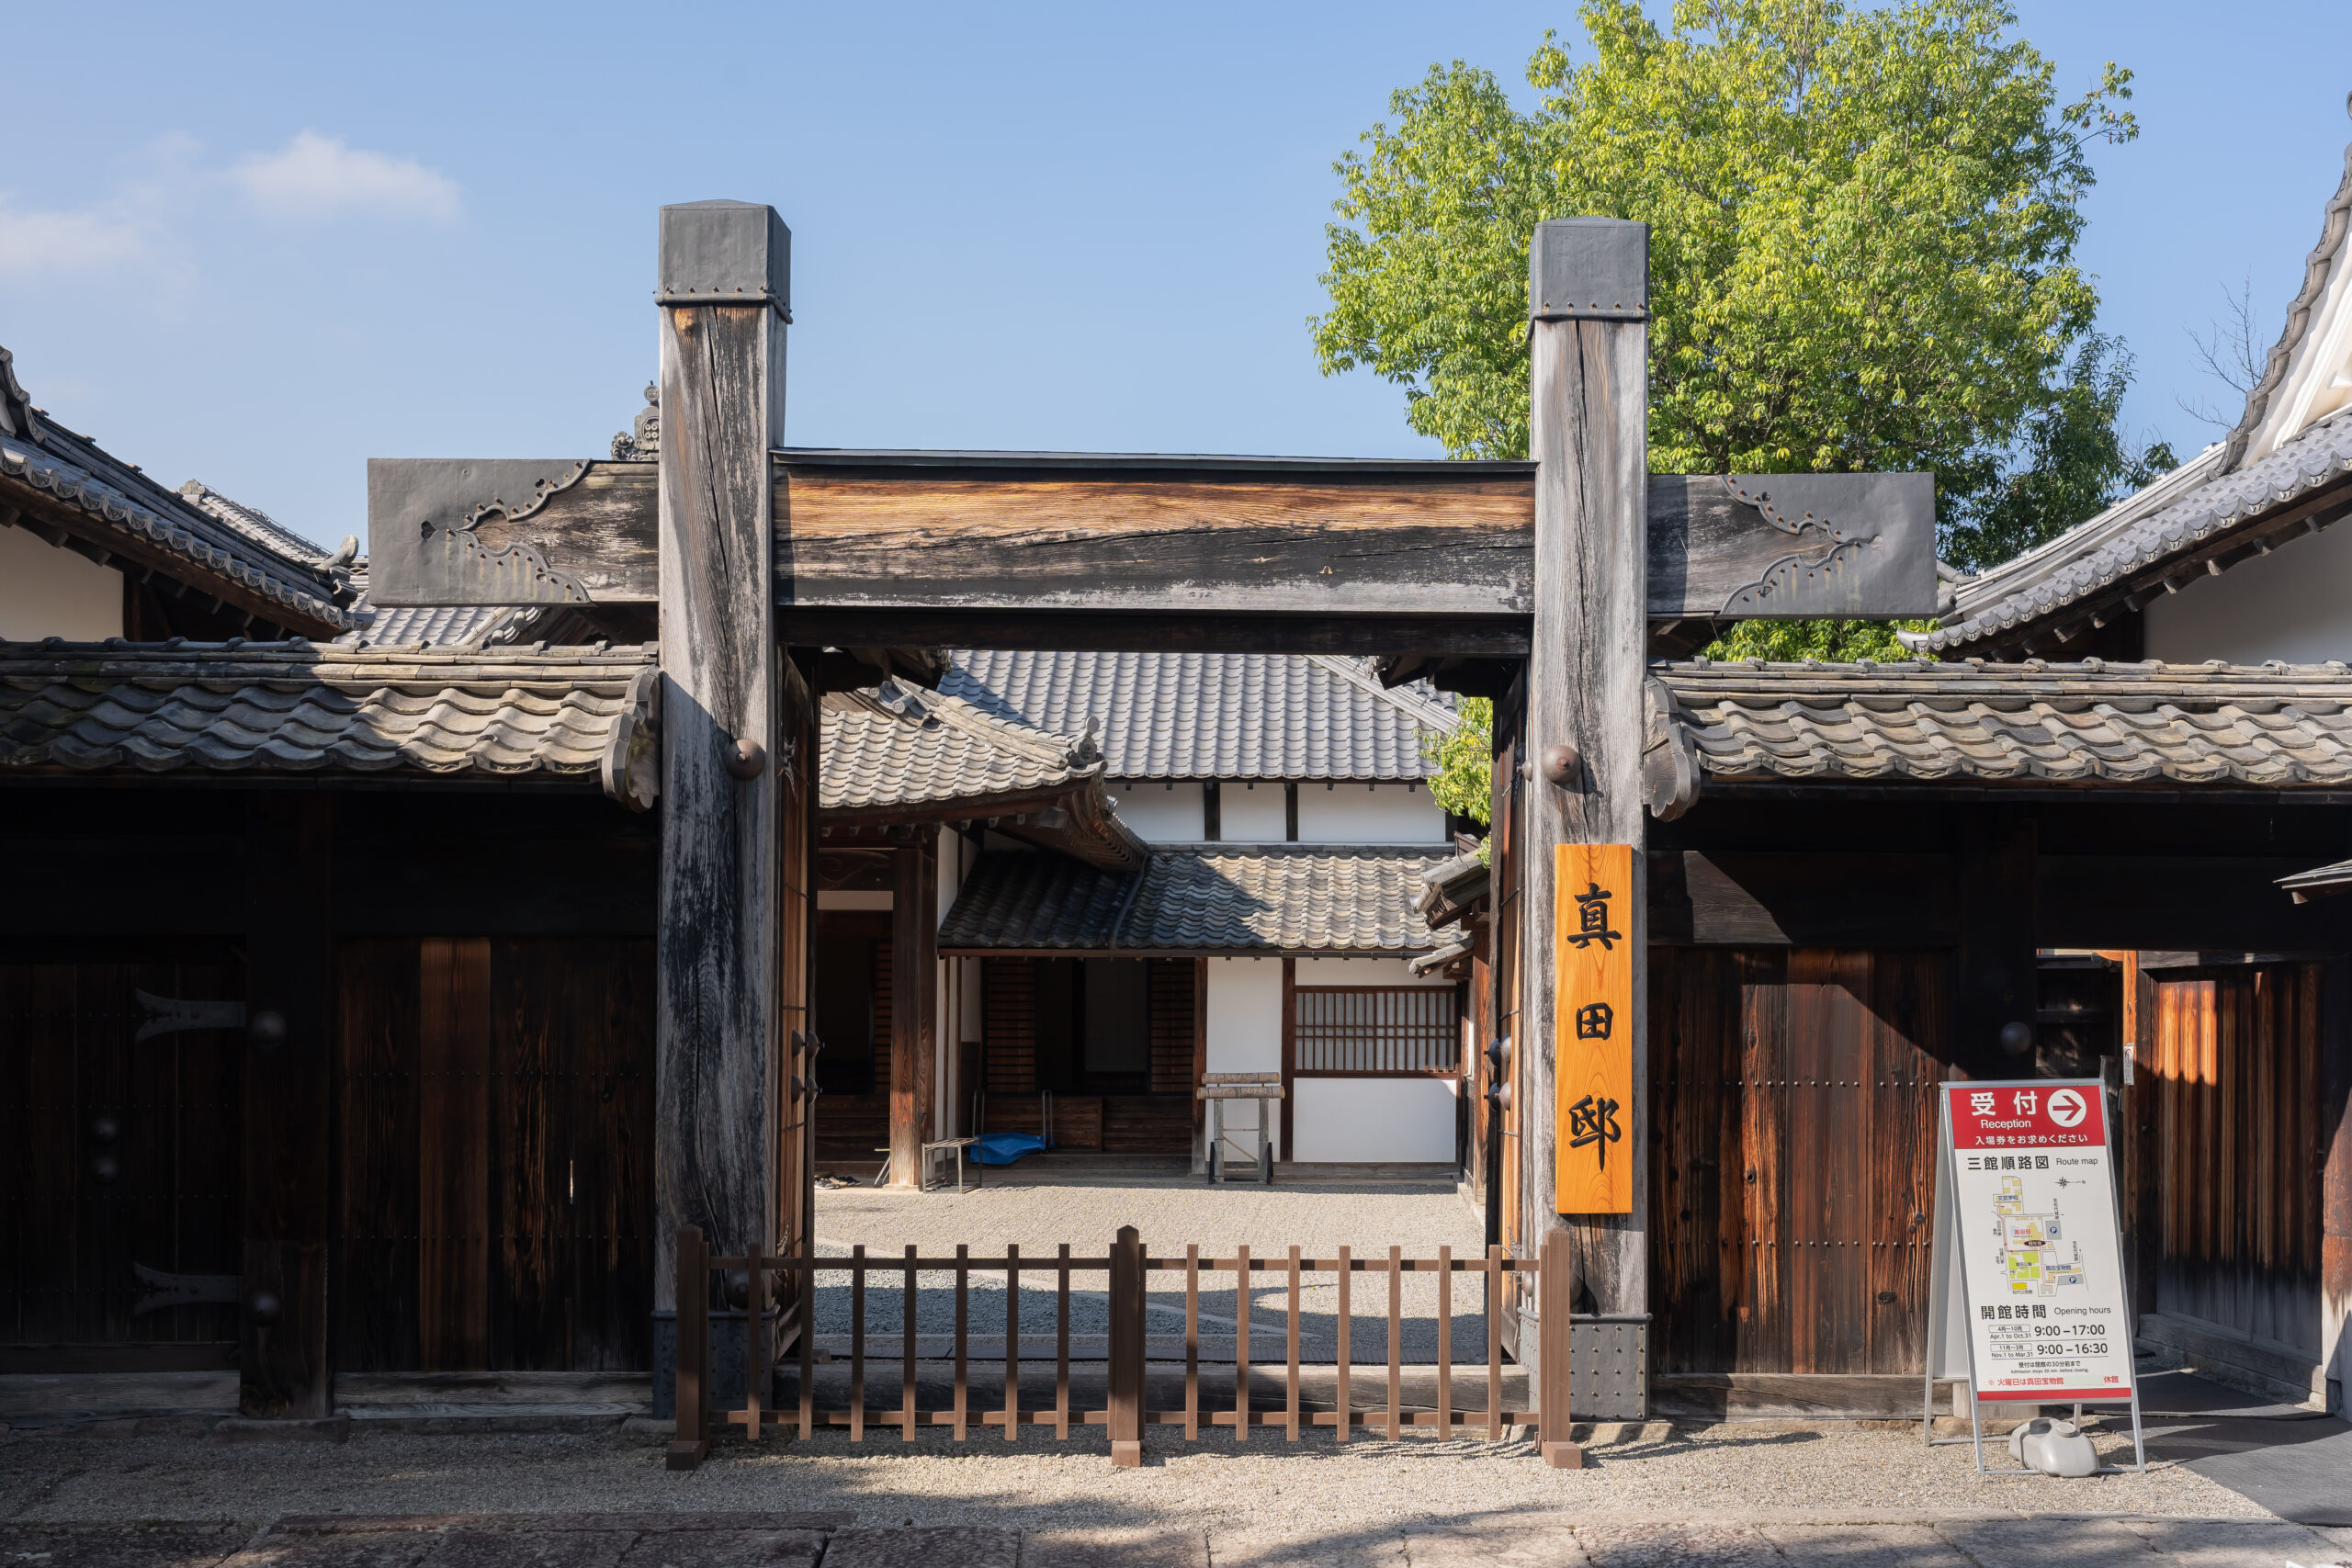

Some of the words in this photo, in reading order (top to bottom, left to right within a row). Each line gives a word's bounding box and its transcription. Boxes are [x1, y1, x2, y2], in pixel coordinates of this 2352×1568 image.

[1567, 883, 1622, 1173] 真田邸
[1970, 1090, 2039, 1116] 受付
[1981, 1120, 2031, 1130] Reception
[1975, 1134, 2088, 1145] 入場券をお求めください
[1967, 1156, 2049, 1170] 三館順路図
[2056, 1157, 2079, 1166] Route
[2081, 1157, 2098, 1167] map
[1981, 1304, 2047, 1320] 開館時間
[2054, 1307, 2087, 1316] Opening
[2089, 1306, 2111, 1314] hours
